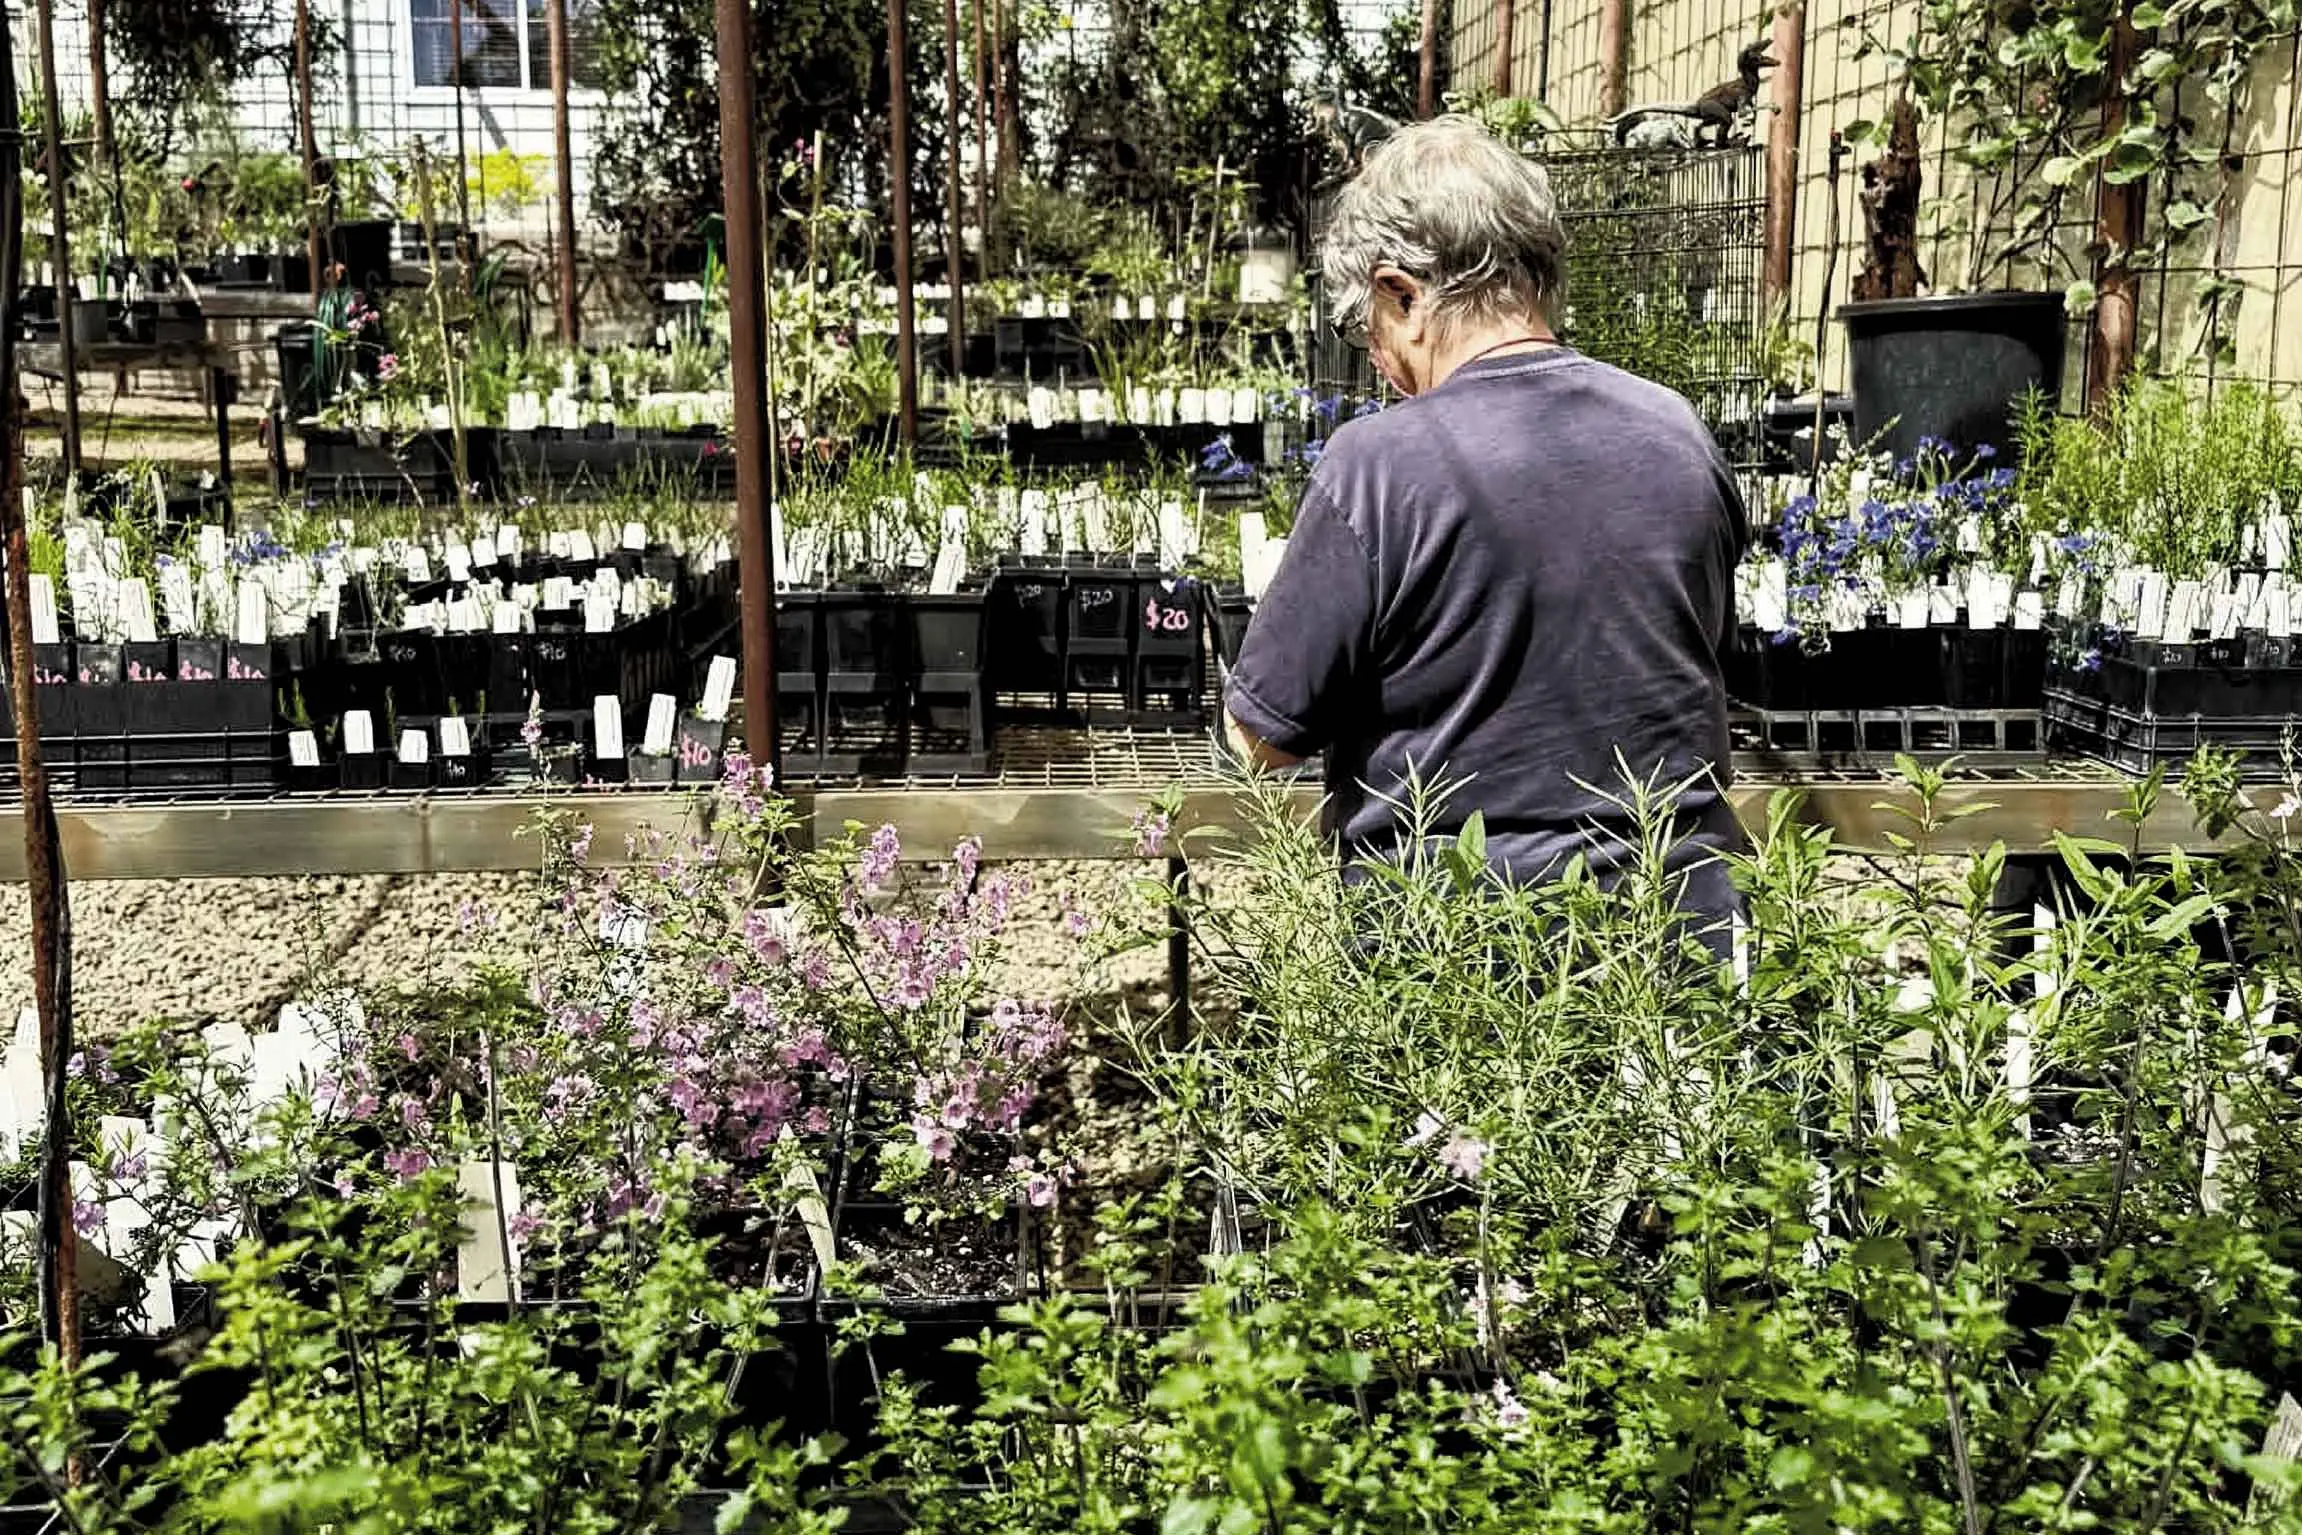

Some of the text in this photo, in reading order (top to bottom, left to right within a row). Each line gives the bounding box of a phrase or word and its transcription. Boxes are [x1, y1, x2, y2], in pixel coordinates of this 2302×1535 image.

[1081, 588, 1113, 613] $20
[1146, 597, 1190, 630] $20
[680, 732, 712, 770] $10
